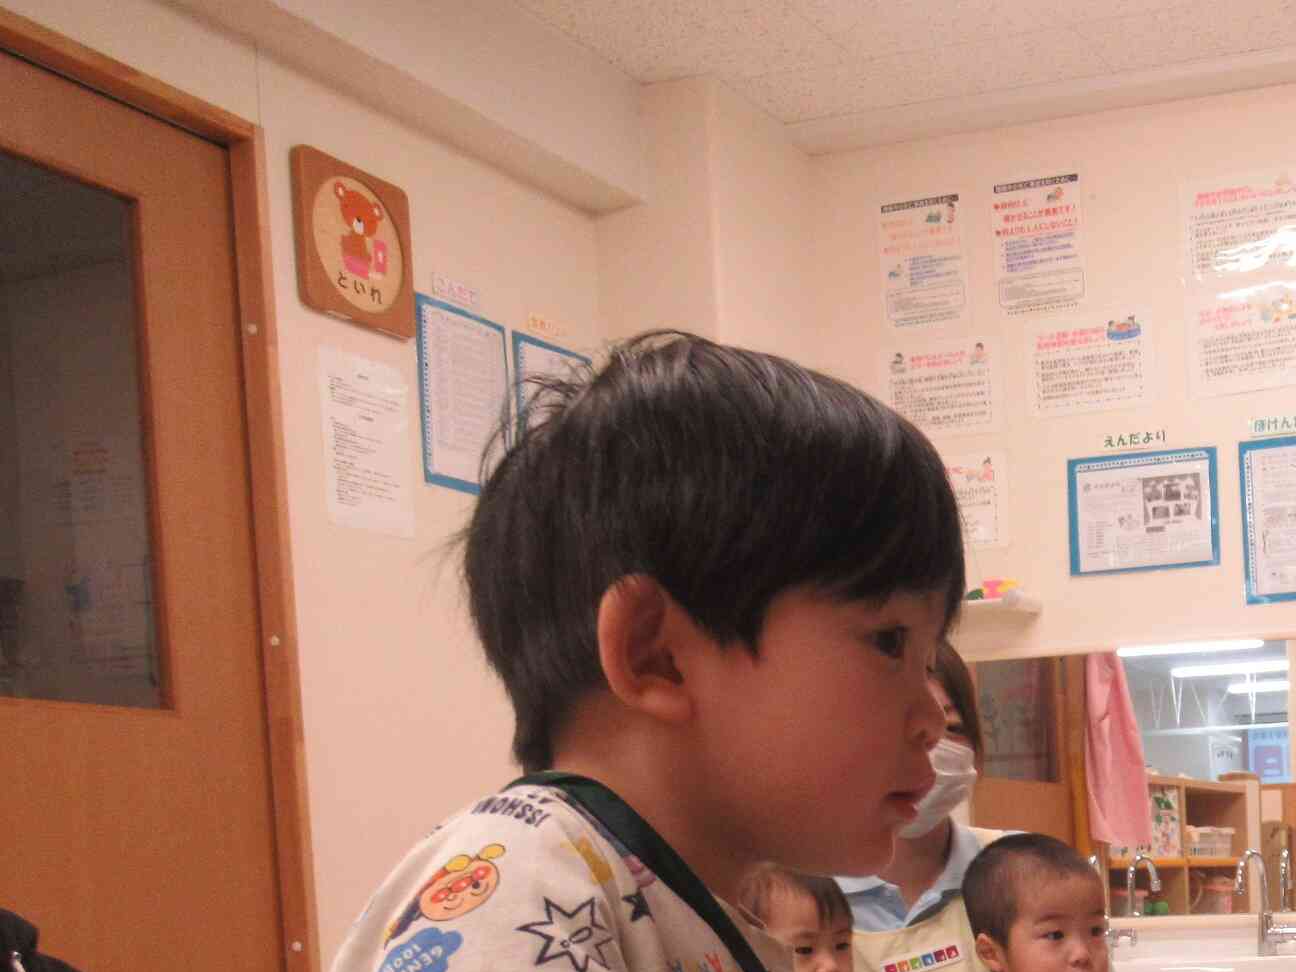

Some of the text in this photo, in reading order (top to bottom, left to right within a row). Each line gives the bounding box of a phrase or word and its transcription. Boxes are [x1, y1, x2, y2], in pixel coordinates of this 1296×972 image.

[337, 271, 382, 304] といれ
[1103, 429, 1167, 448] えんだより
[471, 796, 550, 829] ISSHONI
